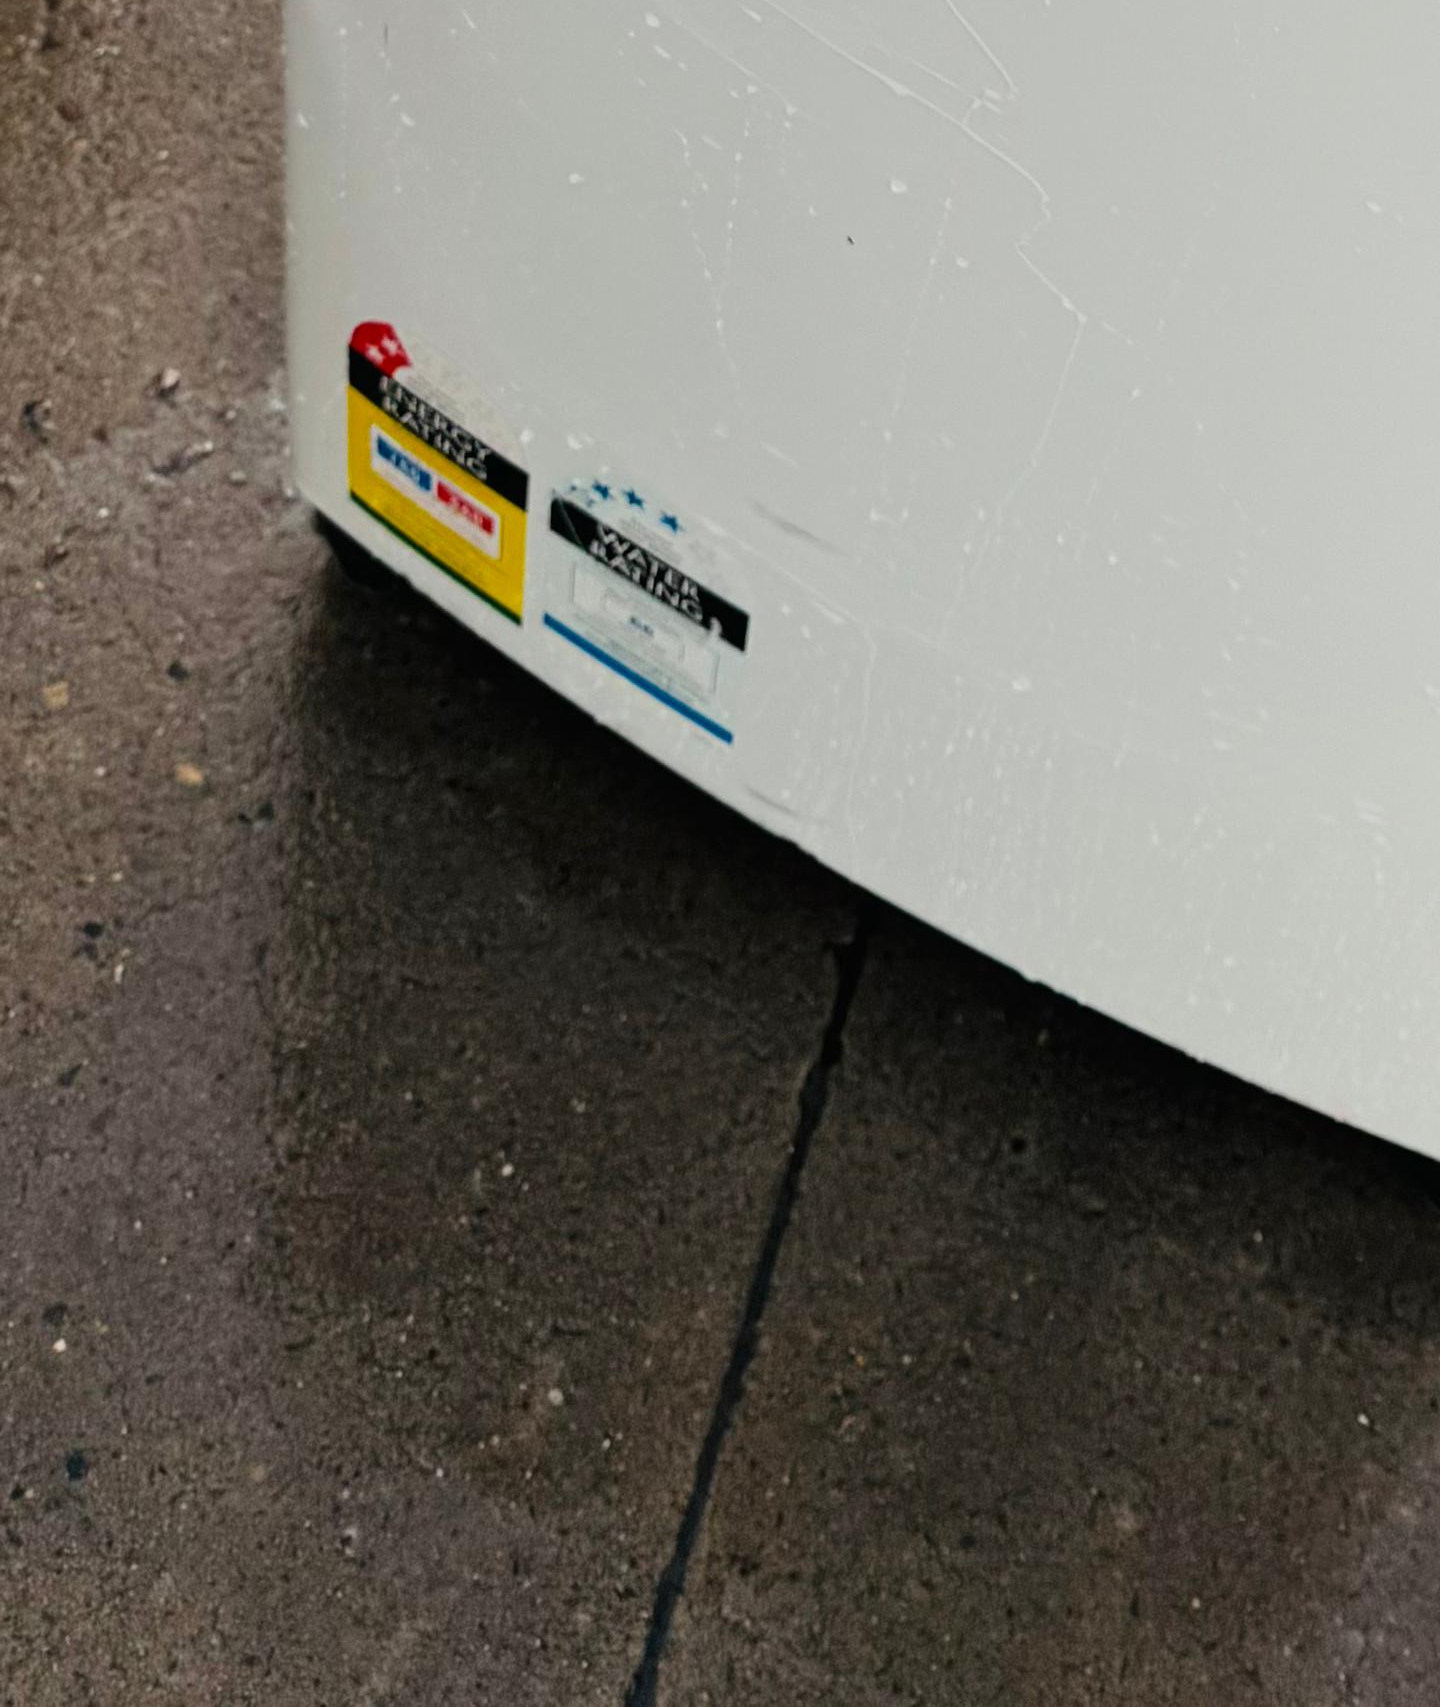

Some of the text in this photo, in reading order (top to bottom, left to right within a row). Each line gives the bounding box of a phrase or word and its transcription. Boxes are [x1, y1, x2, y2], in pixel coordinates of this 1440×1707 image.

[379, 375, 491, 460] ENERGY
[381, 395, 487, 481] RATING
[589, 539, 703, 622] RATING
[597, 525, 701, 602] WATER
